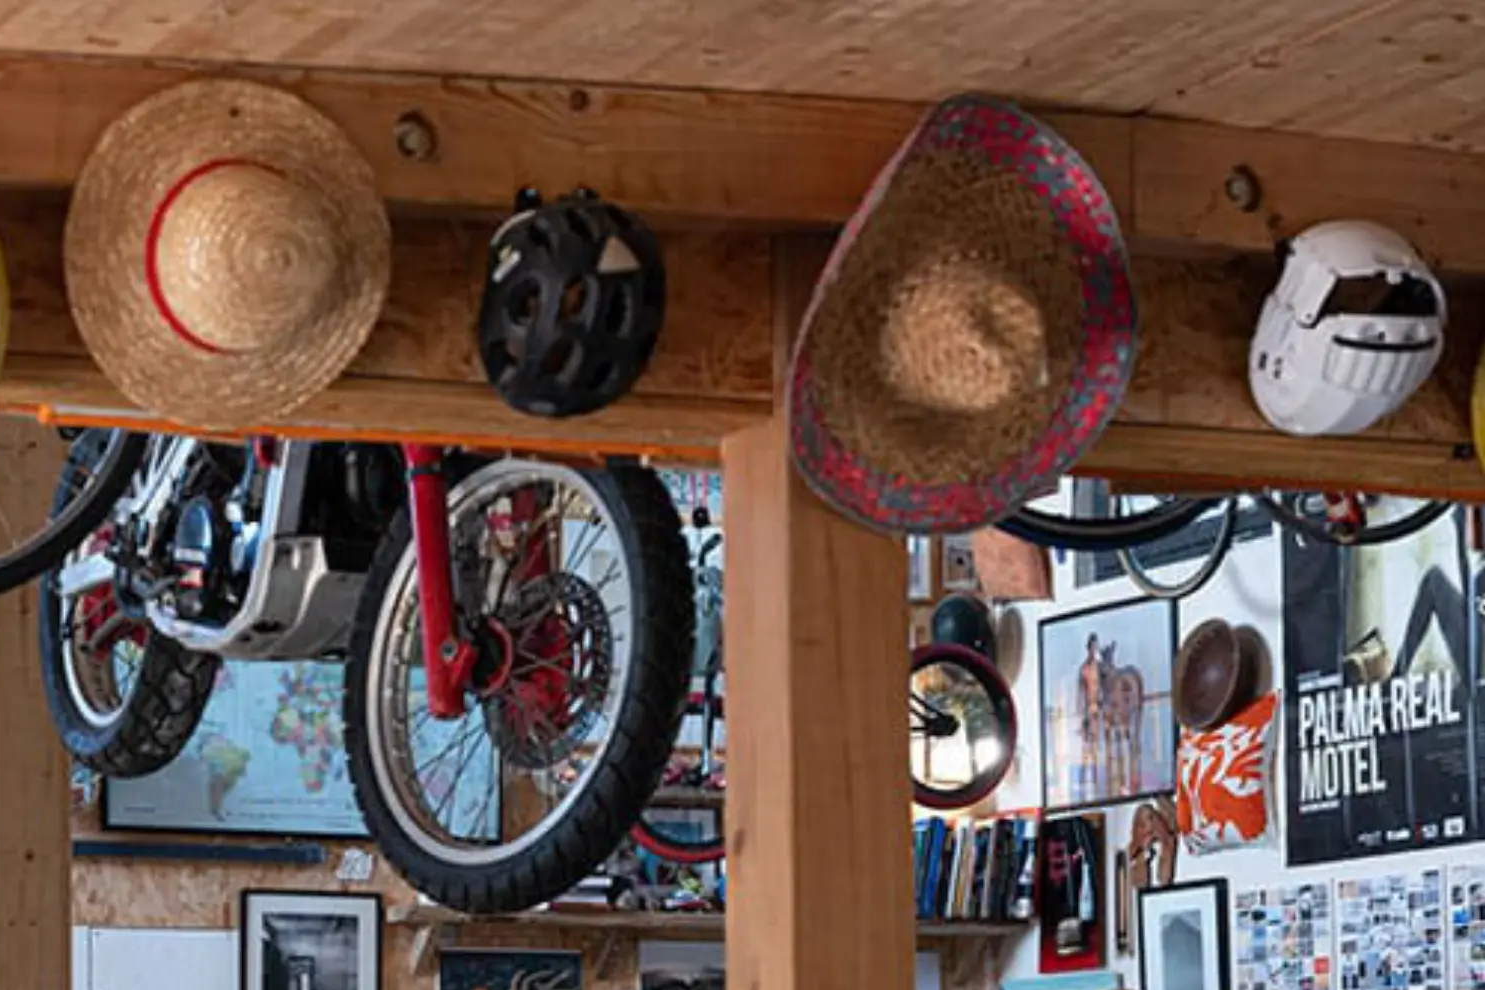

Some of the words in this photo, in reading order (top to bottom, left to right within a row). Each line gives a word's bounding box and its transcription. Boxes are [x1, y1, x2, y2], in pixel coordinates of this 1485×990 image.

[1298, 682, 1386, 748] PALMA
[1389, 670, 1461, 732] REAL
[1300, 738, 1387, 801] MOTEL
